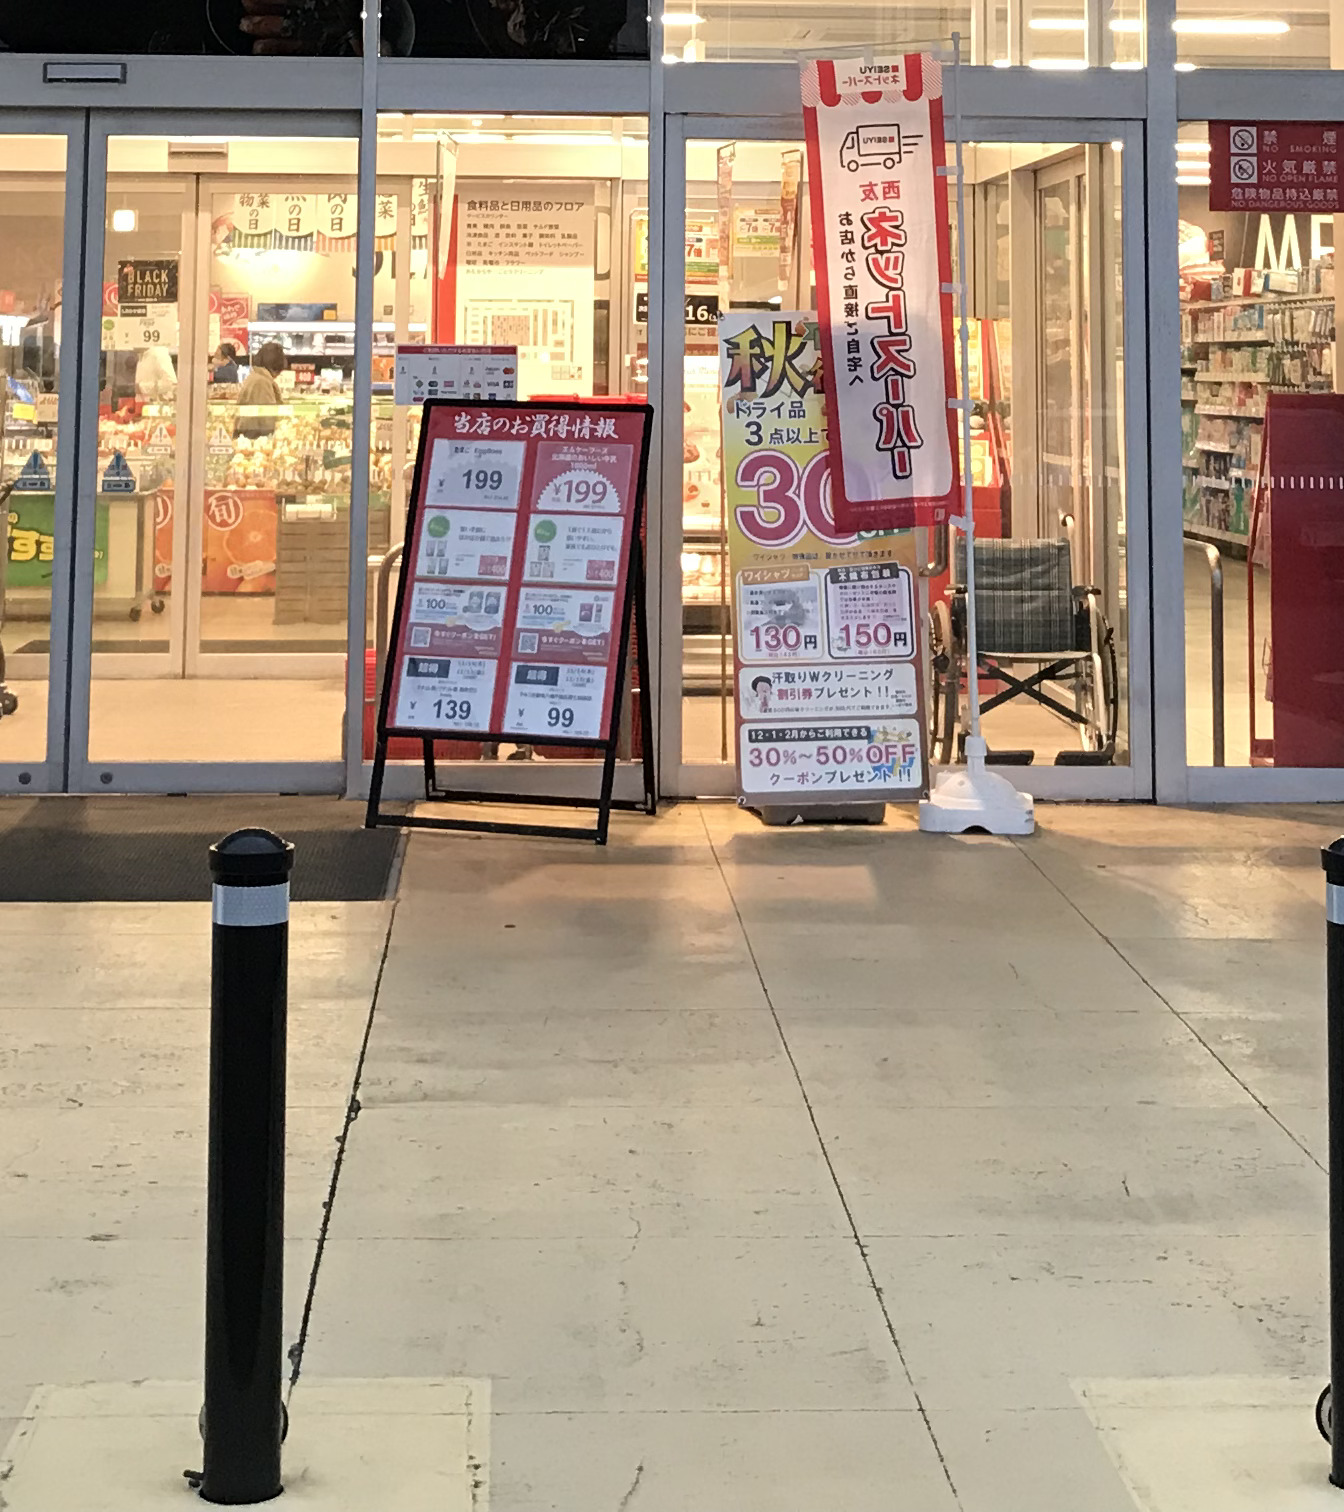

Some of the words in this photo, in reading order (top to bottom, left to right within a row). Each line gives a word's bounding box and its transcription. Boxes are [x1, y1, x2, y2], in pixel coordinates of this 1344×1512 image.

[1262, 145, 1279, 153] NO
[1289, 144, 1337, 154] SMOKING
[1262, 159, 1338, 175] 火気厳禁
[1262, 174, 1277, 183] NO
[1279, 174, 1306, 183] OPEN
[1308, 174, 1338, 184] FLAME
[1230, 187, 1339, 201] 危険物品持込厳禁
[466, 199, 585, 212] 食料品と日用品のフロア
[1248, 200, 1304, 209] DANGEROUS
[127, 269, 169, 284] BLACK
[127, 284, 169, 297] FRIDAY
[142, 329, 161, 343] 99
[453, 412, 619, 440] 当店のお買得情報
[461, 468, 504, 491] 199
[563, 479, 608, 504] 199
[208, 498, 236, 524] 旬
[743, 568, 792, 582] ワイシャツ
[425, 598, 446, 610] 100
[532, 603, 554, 616] 100
[749, 624, 818, 652] 130円
[839, 622, 908, 648] 150円
[771, 667, 894, 685] 汗取りWクリーニング
[777, 685, 890, 701] 割引券プレゼント!!
[432, 698, 472, 721] 139
[546, 707, 576, 729] 99
[750, 727, 869, 741] 12・1・2月からご利用できる
[769, 768, 913, 786] クーポンプレゼント!!
